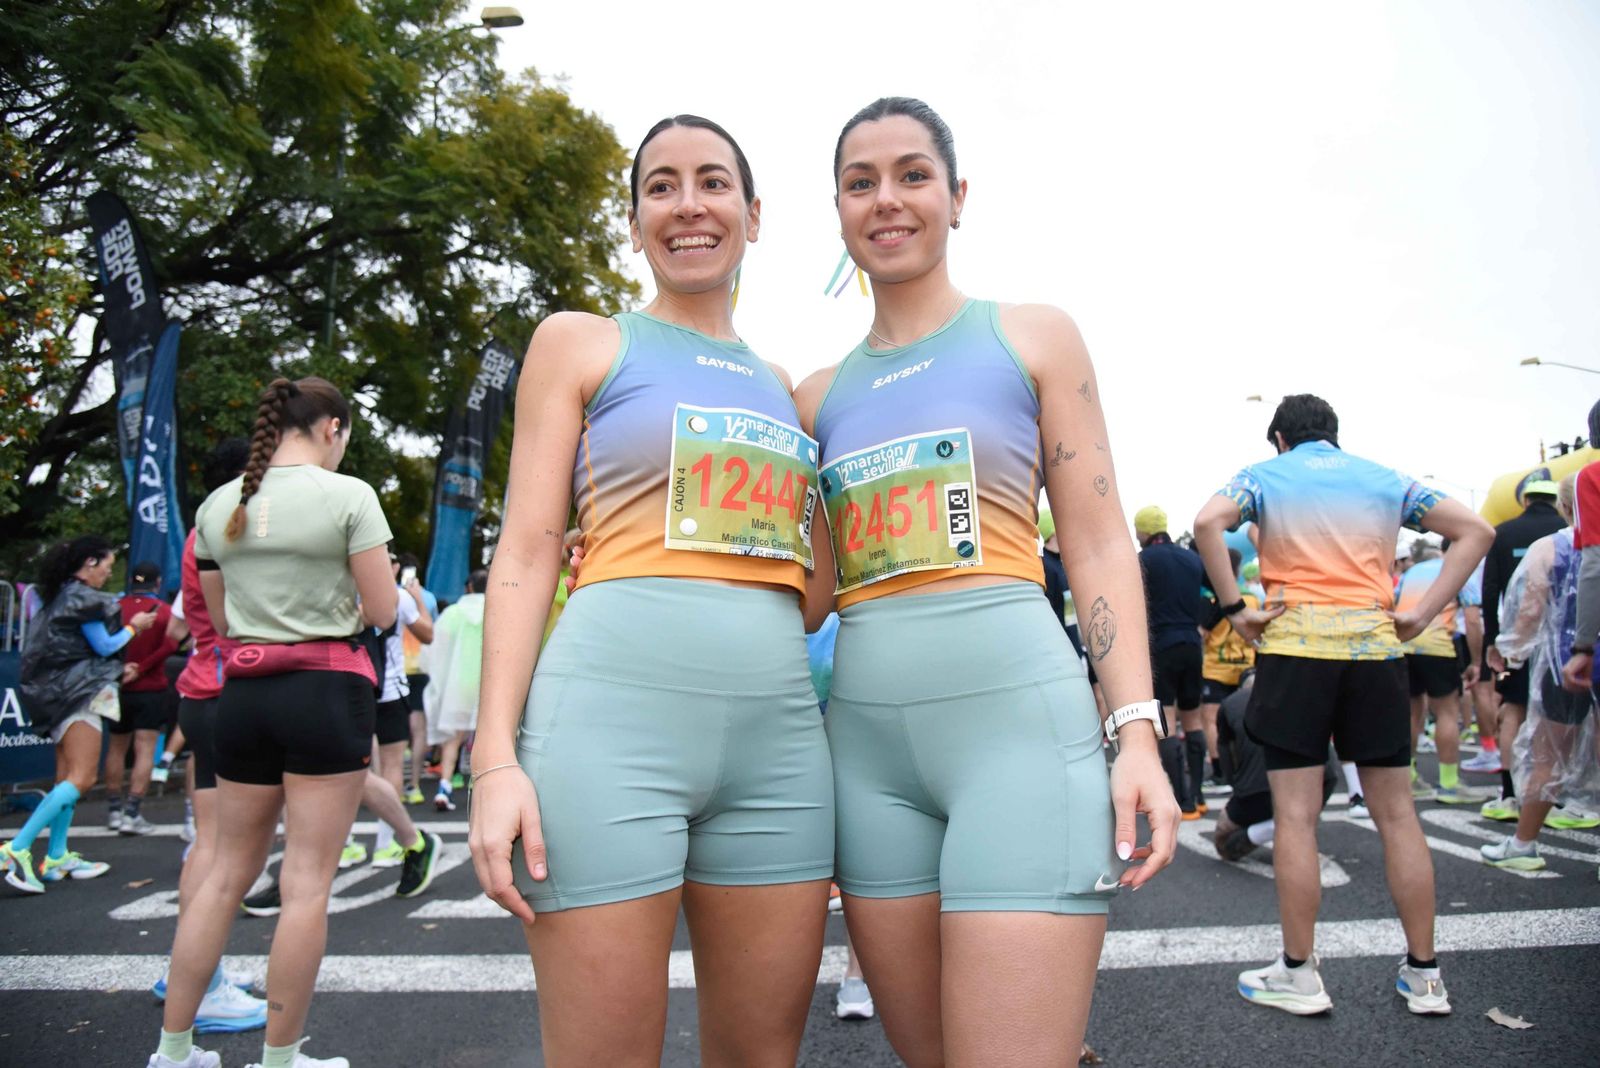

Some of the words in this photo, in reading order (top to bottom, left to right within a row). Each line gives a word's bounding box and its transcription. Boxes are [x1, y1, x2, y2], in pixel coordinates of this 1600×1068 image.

[695, 355, 754, 377] SAYSKY
[872, 358, 935, 389] SAYSKY
[467, 348, 504, 411] POWER
[743, 417, 792, 443] maratón
[758, 433, 794, 454] sevilla
[844, 445, 904, 472] maratón
[862, 455, 904, 479] sevilla
[677, 467, 687, 475] 4
[673, 476, 686, 513] CAJÓN
[691, 453, 808, 523] 12447
[749, 536, 769, 546] Rico
[868, 548, 886, 560] Irene
[887, 557, 930, 571] Retamosa
